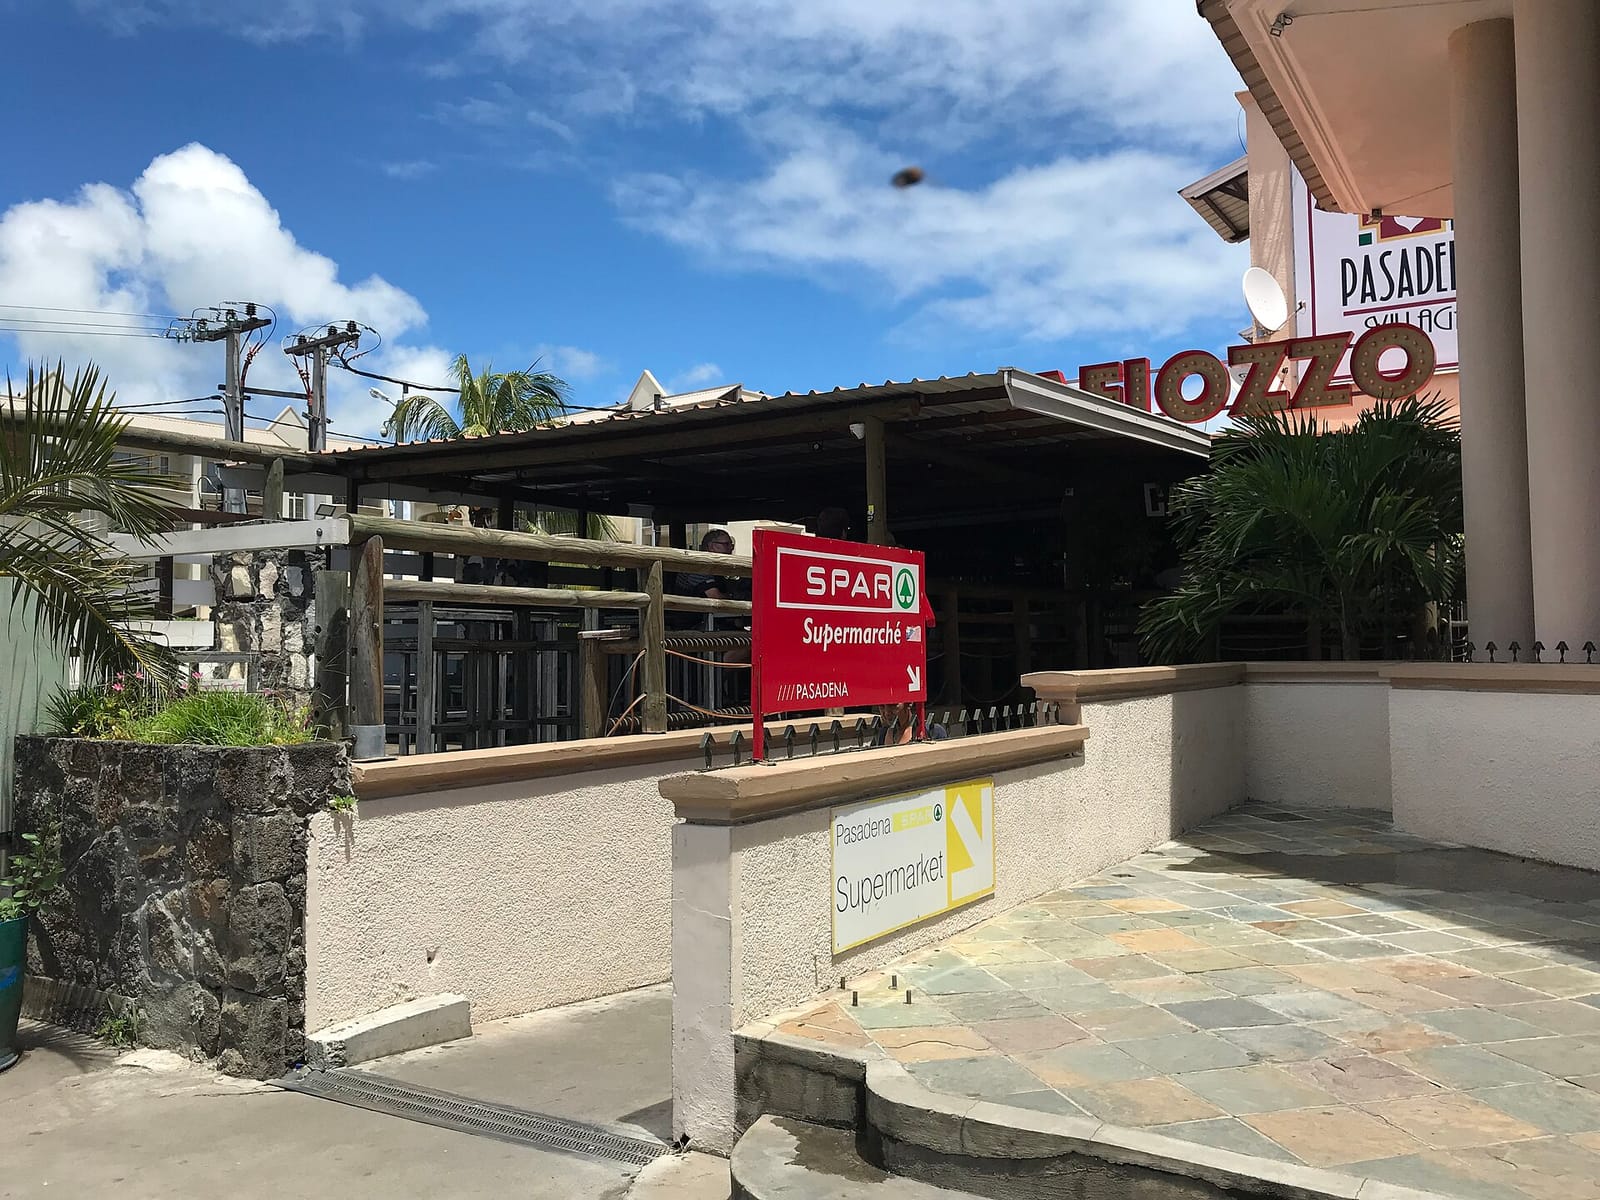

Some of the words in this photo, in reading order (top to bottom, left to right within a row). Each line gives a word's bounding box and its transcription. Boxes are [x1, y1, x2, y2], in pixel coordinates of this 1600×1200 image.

[806, 565, 892, 600] SPAR
[802, 616, 902, 652] Supermarché
[836, 816, 891, 846] Pasadena
[836, 850, 944, 914] Supermarket
